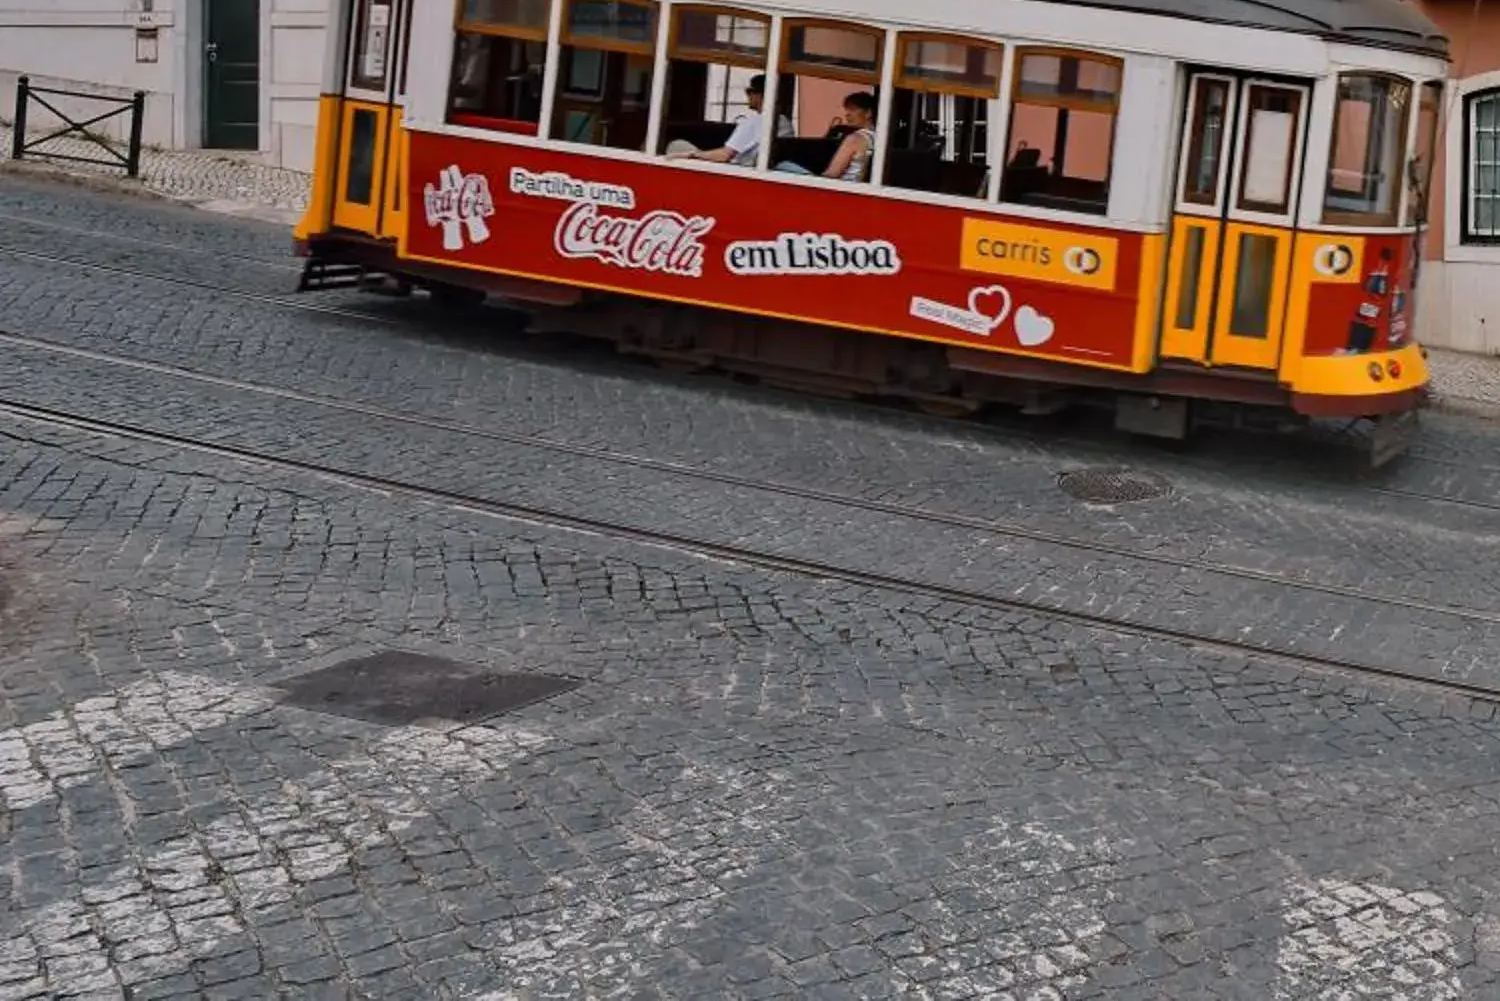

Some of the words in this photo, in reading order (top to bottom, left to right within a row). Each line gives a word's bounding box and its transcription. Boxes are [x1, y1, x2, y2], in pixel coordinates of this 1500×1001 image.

[513, 171, 584, 198] Partilha
[589, 187, 632, 204] uma
[730, 246, 781, 269] em
[786, 238, 895, 270] Lisboa
[976, 238, 1051, 266] carris
